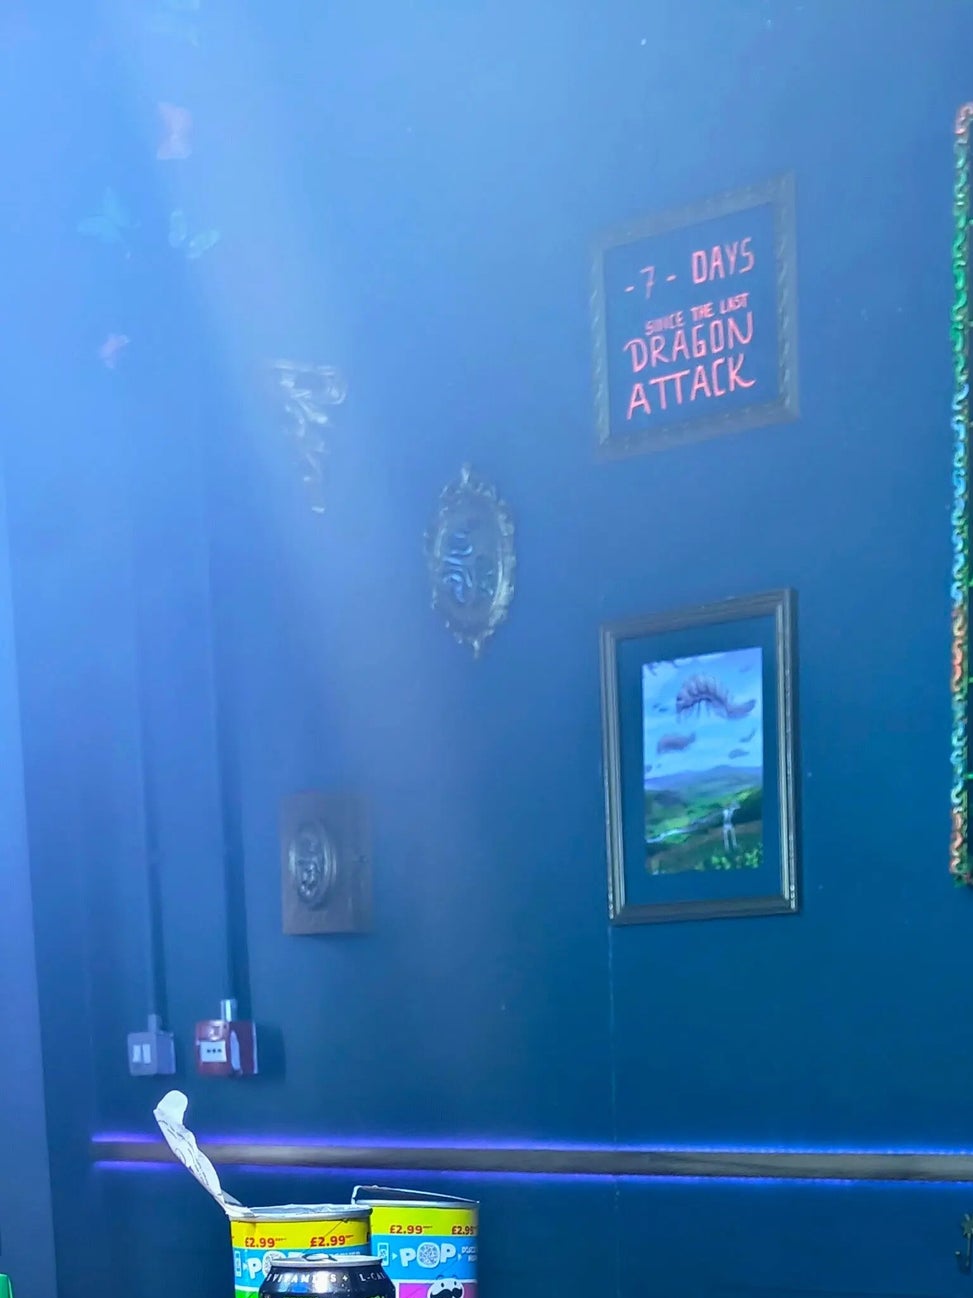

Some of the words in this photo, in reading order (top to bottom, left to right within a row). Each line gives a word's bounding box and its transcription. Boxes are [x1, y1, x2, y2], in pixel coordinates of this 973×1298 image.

[691, 237, 754, 284] DAYS
[645, 311, 685, 336] SINCE
[690, 302, 715, 321] THE
[720, 292, 749, 315] LAST
[623, 311, 753, 373] DRAGON
[627, 353, 757, 420] ATTACK
[245, 1237, 275, 1248] £2.99
[310, 1234, 346, 1247] £2.99
[390, 1225, 423, 1235] £2.99
[400, 1242, 456, 1268] POP
